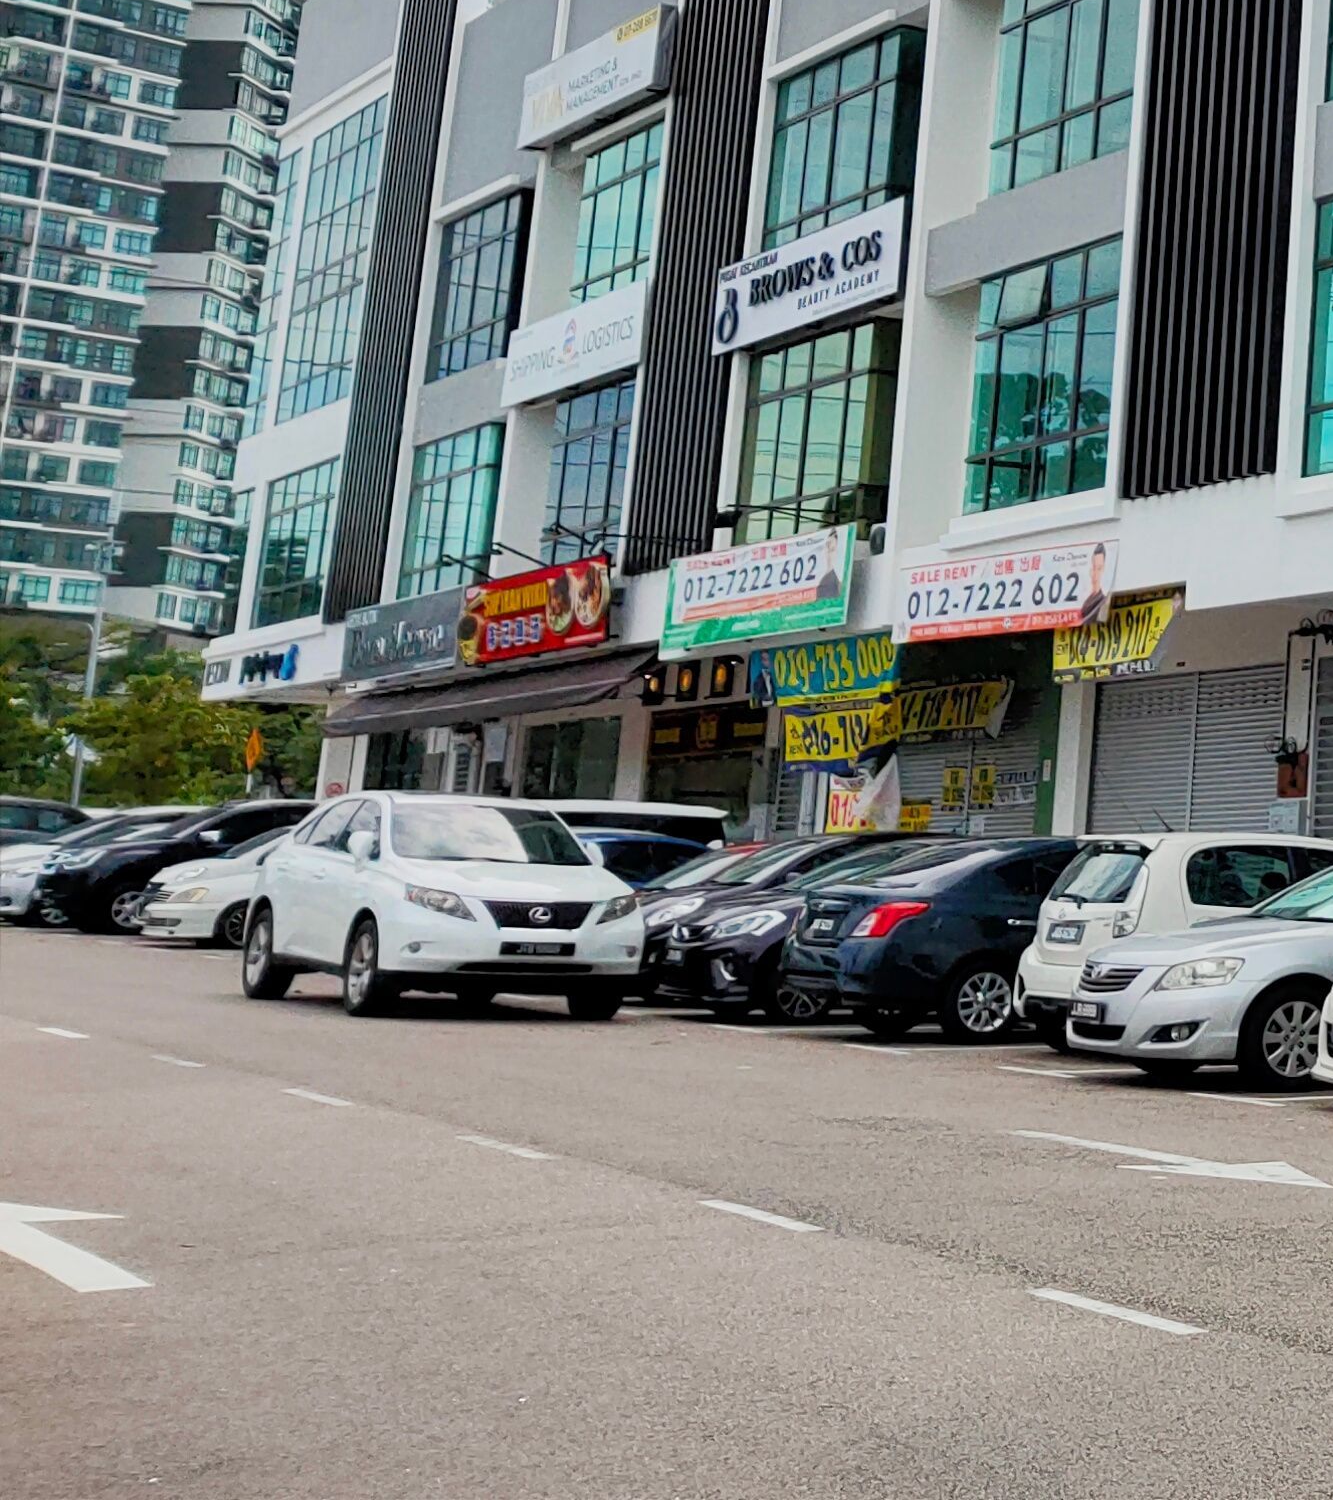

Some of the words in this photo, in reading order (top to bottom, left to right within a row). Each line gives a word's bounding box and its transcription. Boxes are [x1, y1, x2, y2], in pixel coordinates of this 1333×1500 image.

[748, 255, 816, 308] BROWS
[817, 251, 836, 281] &
[841, 229, 883, 272] COS
[797, 287, 830, 310] BEAUTY
[834, 268, 880, 297] ACADEMY
[581, 315, 635, 355] LOGISTICS
[683, 563, 773, 603] 012-7222
[779, 553, 818, 586] 602
[907, 577, 1023, 620] 012-7222
[1031, 571, 1080, 606] 602
[910, 569, 941, 585] SALE
[943, 564, 977, 581] RENT
